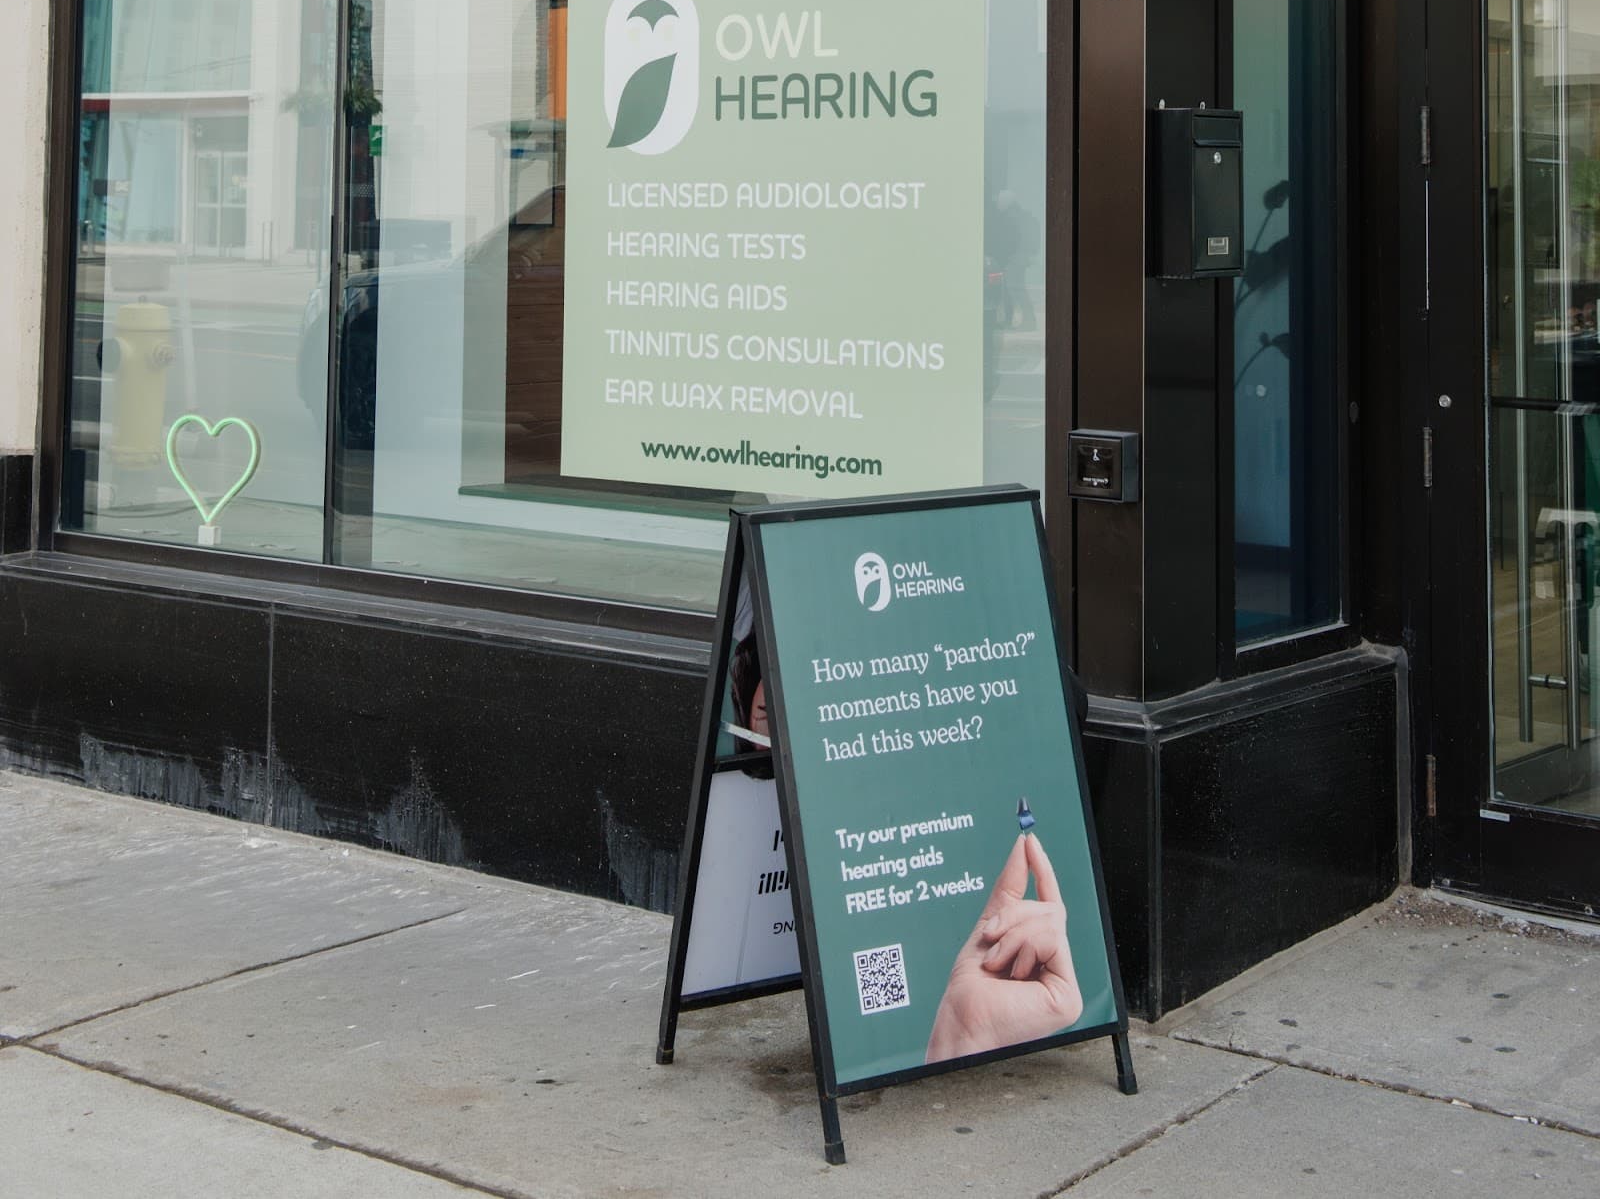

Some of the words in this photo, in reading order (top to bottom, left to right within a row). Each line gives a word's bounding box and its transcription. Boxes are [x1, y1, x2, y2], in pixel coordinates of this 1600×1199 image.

[715, 10, 839, 61] OWL
[715, 69, 937, 121] HEARING
[608, 183, 728, 208] LICENSED
[736, 182, 925, 209] AUDIOLOGIST
[607, 232, 719, 258] HEARING
[727, 234, 806, 260] TESTS
[607, 281, 719, 309] HEARING
[727, 284, 787, 311] AIDS
[605, 329, 719, 359] TINNITUS
[727, 335, 945, 370] CONSULATIONS
[605, 379, 654, 406] EAR
[661, 382, 723, 410] WAX
[731, 386, 863, 419] REMOVAL
[641, 441, 882, 479] www.owlhearing.com
[893, 561, 933, 579] OWL
[895, 576, 965, 598] HEARING
[812, 658, 863, 683] How
[870, 651, 929, 675] many
[934, 631, 1035, 671] “pardon?”
[818, 690, 921, 722] moments
[925, 683, 976, 707] have
[979, 679, 1018, 704] you
[822, 733, 867, 762] had
[872, 728, 914, 755] this
[918, 715, 984, 747] week?
[835, 829, 865, 852] Try
[868, 827, 897, 844] our
[900, 812, 974, 844] premium
[841, 855, 907, 882] hearing
[910, 845, 944, 870] aids
[846, 888, 887, 914] FREE
[889, 885, 913, 906] for
[916, 881, 930, 902] 2
[931, 871, 985, 899] weeks
